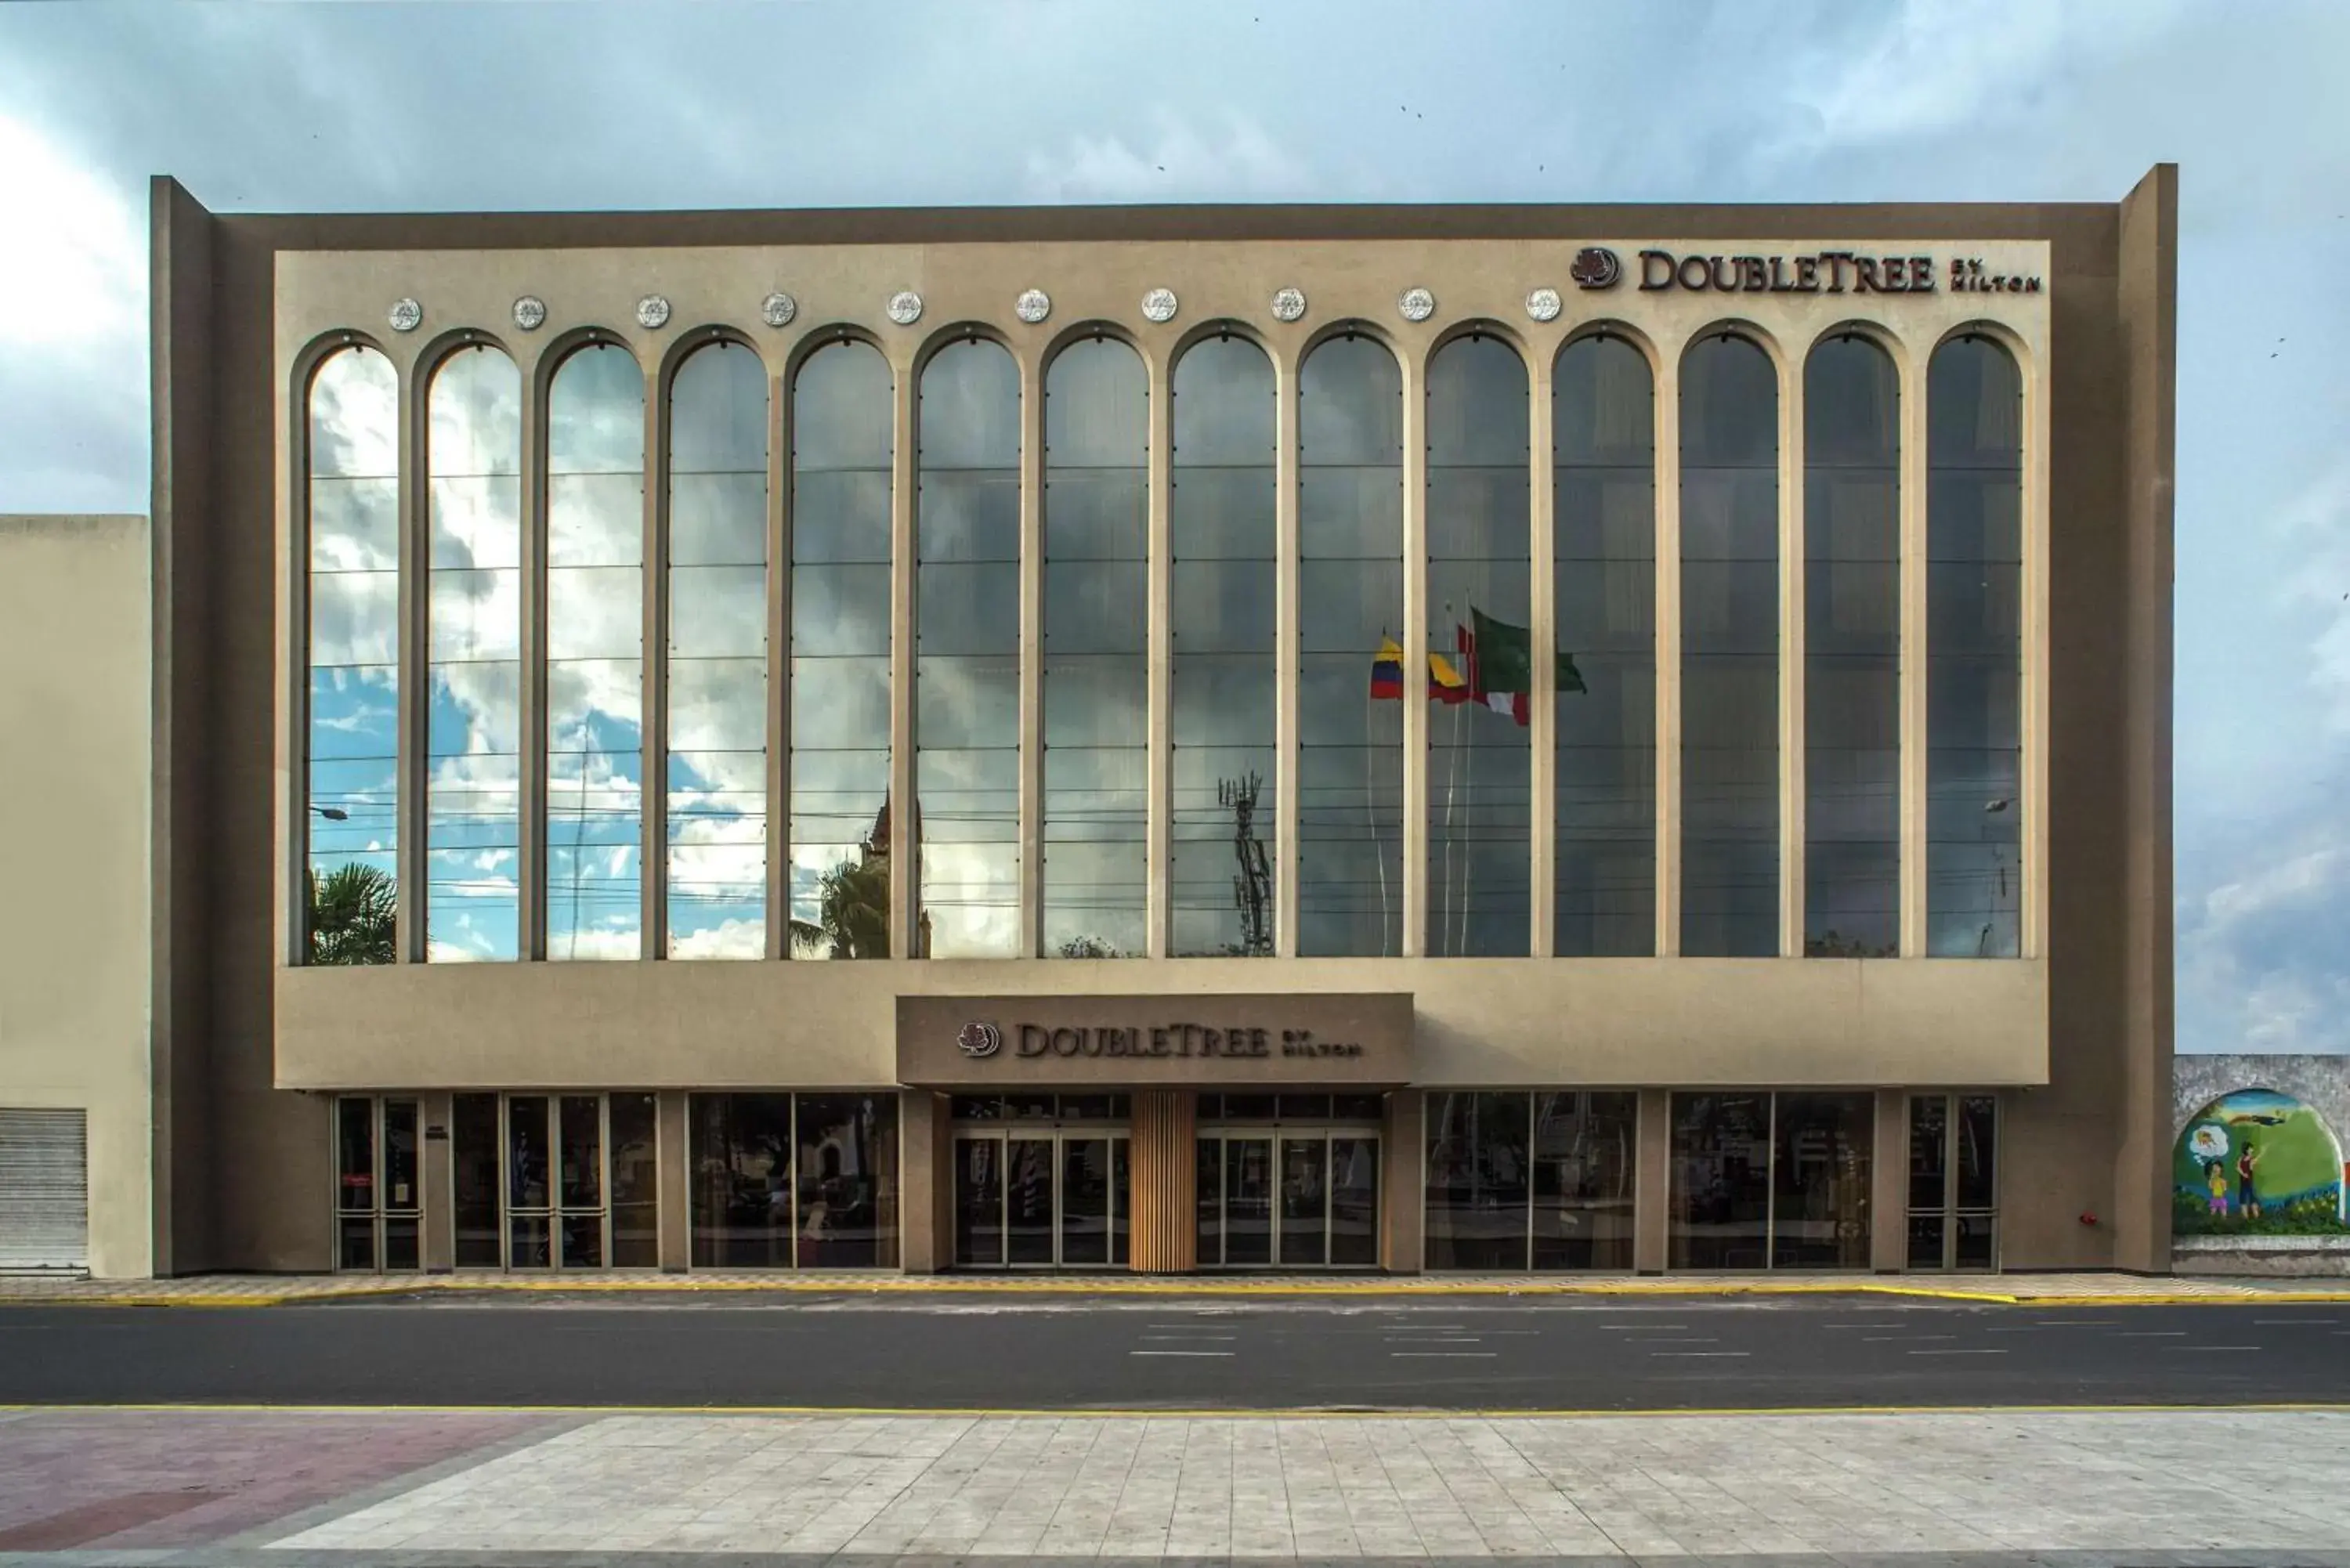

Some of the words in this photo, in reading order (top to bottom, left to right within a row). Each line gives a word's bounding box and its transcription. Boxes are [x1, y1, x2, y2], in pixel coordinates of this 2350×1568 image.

[1638, 251, 1936, 292] DOUBLETREE
[1950, 258, 1983, 274] BY
[1950, 275, 2041, 293] HILTON
